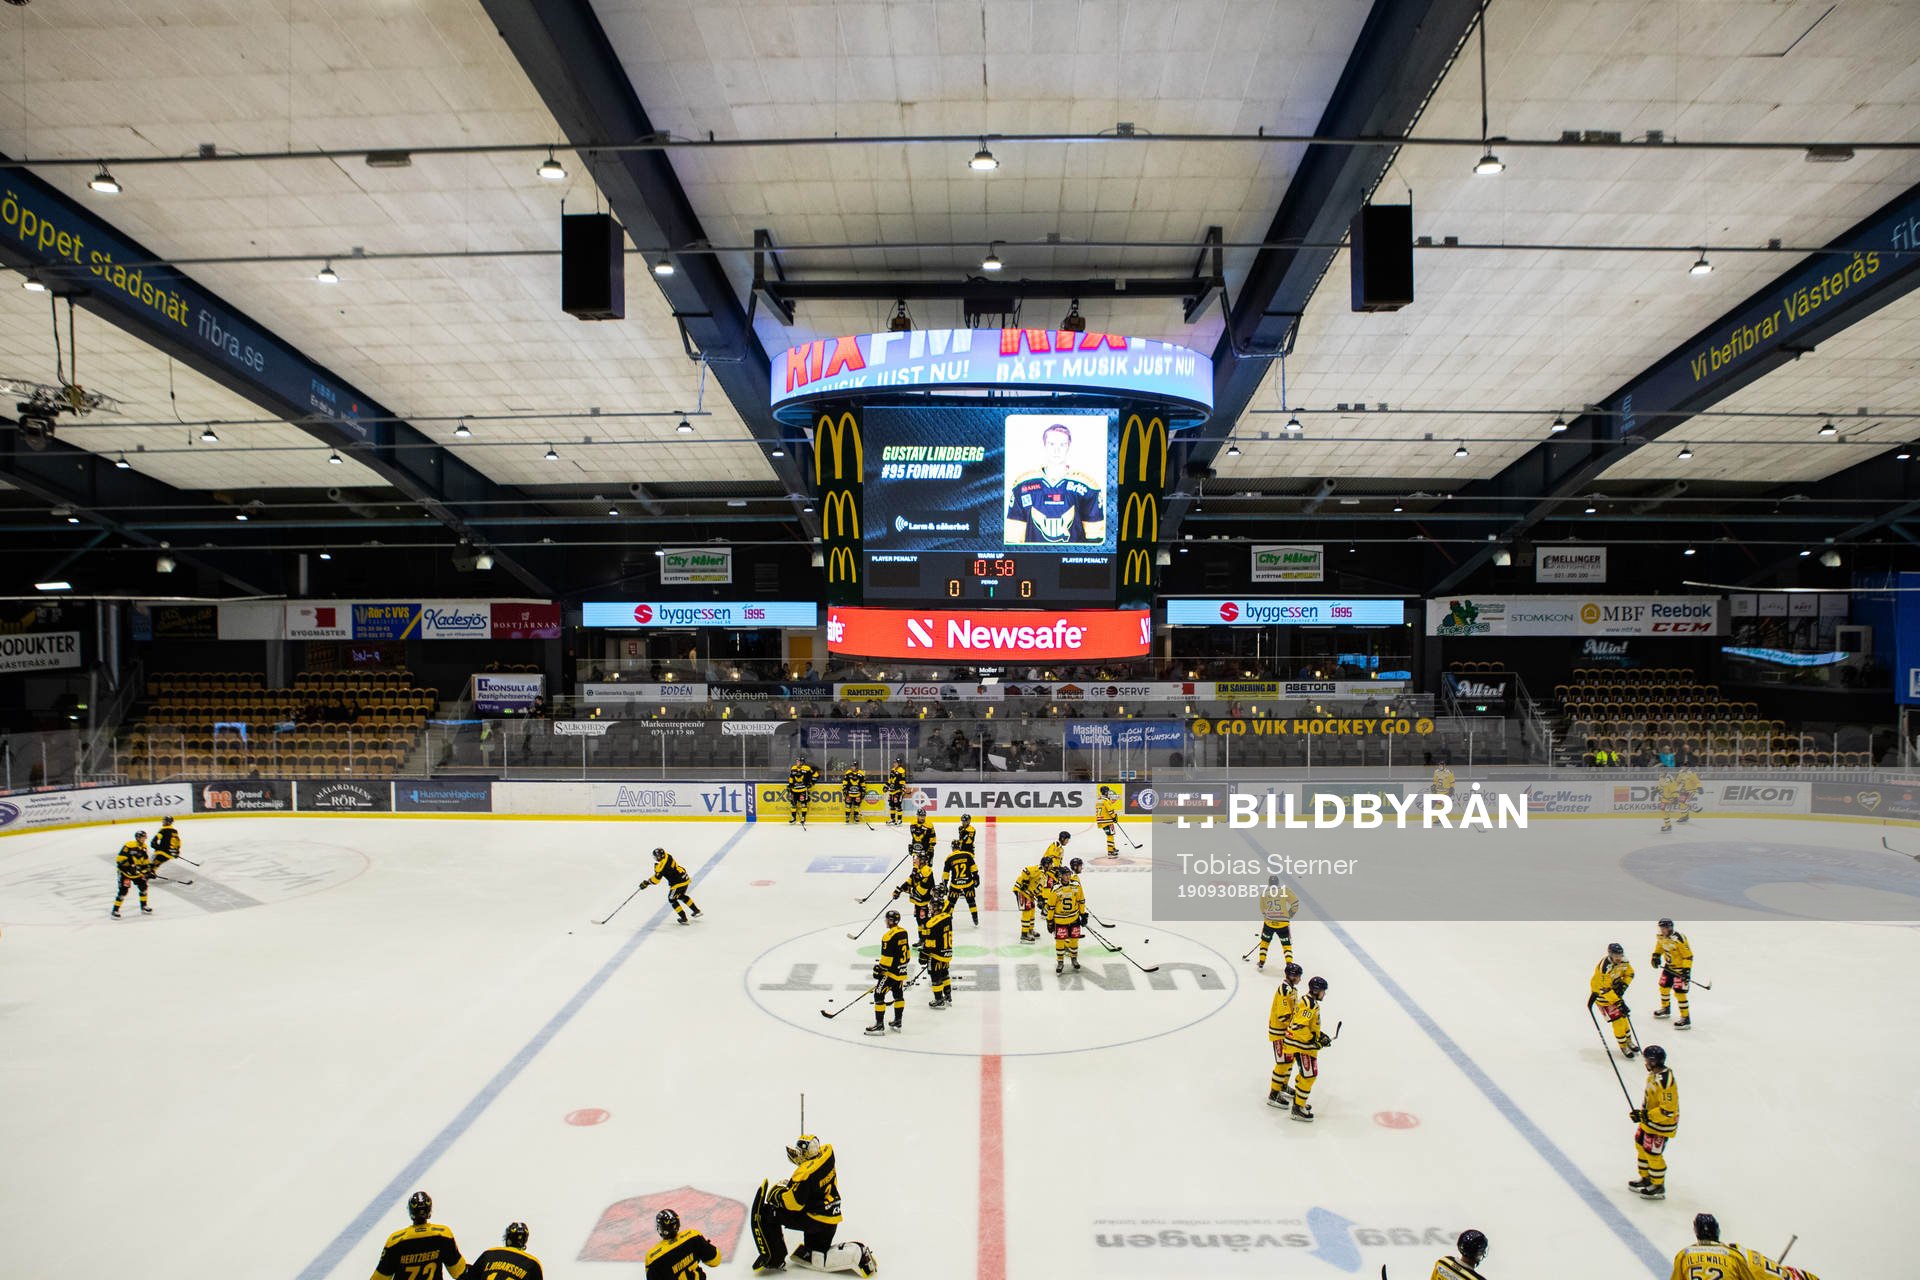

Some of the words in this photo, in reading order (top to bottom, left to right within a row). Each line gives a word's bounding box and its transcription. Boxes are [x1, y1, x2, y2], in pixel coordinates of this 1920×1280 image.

[1, 190, 85, 265] öppet
[90, 250, 189, 327] stadsnät
[198, 308, 266, 373] fibra.se
[1691, 352, 1707, 382] Vi
[1710, 310, 1781, 372] befibrar
[1784, 251, 1880, 324] Västerås
[929, 360, 970, 383] NU!
[1063, 357, 1128, 378] MUSIK
[1133, 356, 1173, 376] JUST
[1175, 356, 1195, 376] NU!
[882, 446, 928, 461] GUSTAV
[926, 446, 985, 462] LINDBERG
[881, 464, 905, 479] #95
[905, 464, 963, 479] FORWARD
[667, 555, 688, 567] City
[1259, 553, 1280, 565] City
[1552, 555, 1601, 563] MELLINGER
[974, 560, 1014, 576] 10:58
[950, 580, 960, 597] 0
[1022, 580, 1032, 597] 0
[392, 607, 409, 618] VVS
[660, 605, 731, 625] byggessen
[744, 609, 765, 619] 1995
[1246, 602, 1318, 622] byggessen
[1331, 607, 1352, 618] 1995
[1603, 606, 1645, 621] MBF
[1651, 604, 1712, 617] Reebok
[424, 609, 488, 630] Kadesjös
[1512, 614, 1574, 622] STOMKON
[291, 629, 346, 637] BYGGMÄSTER
[948, 619, 1082, 649] Newsafe
[1652, 623, 1712, 633] CCM
[0, 635, 75, 656] ODUKTER
[48, 658, 60, 666] AB
[903, 686, 938, 695] EXIGO
[1218, 684, 1228, 692] EM
[1230, 684, 1265, 692] SANERING
[1266, 684, 1276, 692] AB
[1285, 683, 1336, 691] ABETONG
[722, 688, 768, 700] Kvänum
[555, 721, 605, 734] SALBOHEDS
[641, 720, 704, 730] Markentreprenör
[723, 722, 774, 735] SALBOHEDS
[1217, 719, 1246, 735] GO
[1253, 719, 1287, 735] VIK
[1293, 719, 1377, 735] HOCKEY
[1381, 719, 1410, 735] GO
[809, 727, 840, 740] PAX
[879, 727, 910, 740] PAX
[236, 790, 263, 799] Brand
[331, 795, 357, 806] RÖR
[615, 785, 677, 807] Avans
[701, 786, 742, 813] vlt
[944, 791, 1083, 808] ALFAGLAS
[1533, 791, 1592, 802] CarWash
[1546, 801, 1590, 813] Center
[954, 863, 967, 878] 12
[1267, 900, 1281, 911] 25
[1095, 1229, 1310, 1252] svängen
[400, 1250, 440, 1264] HERTZBERG
